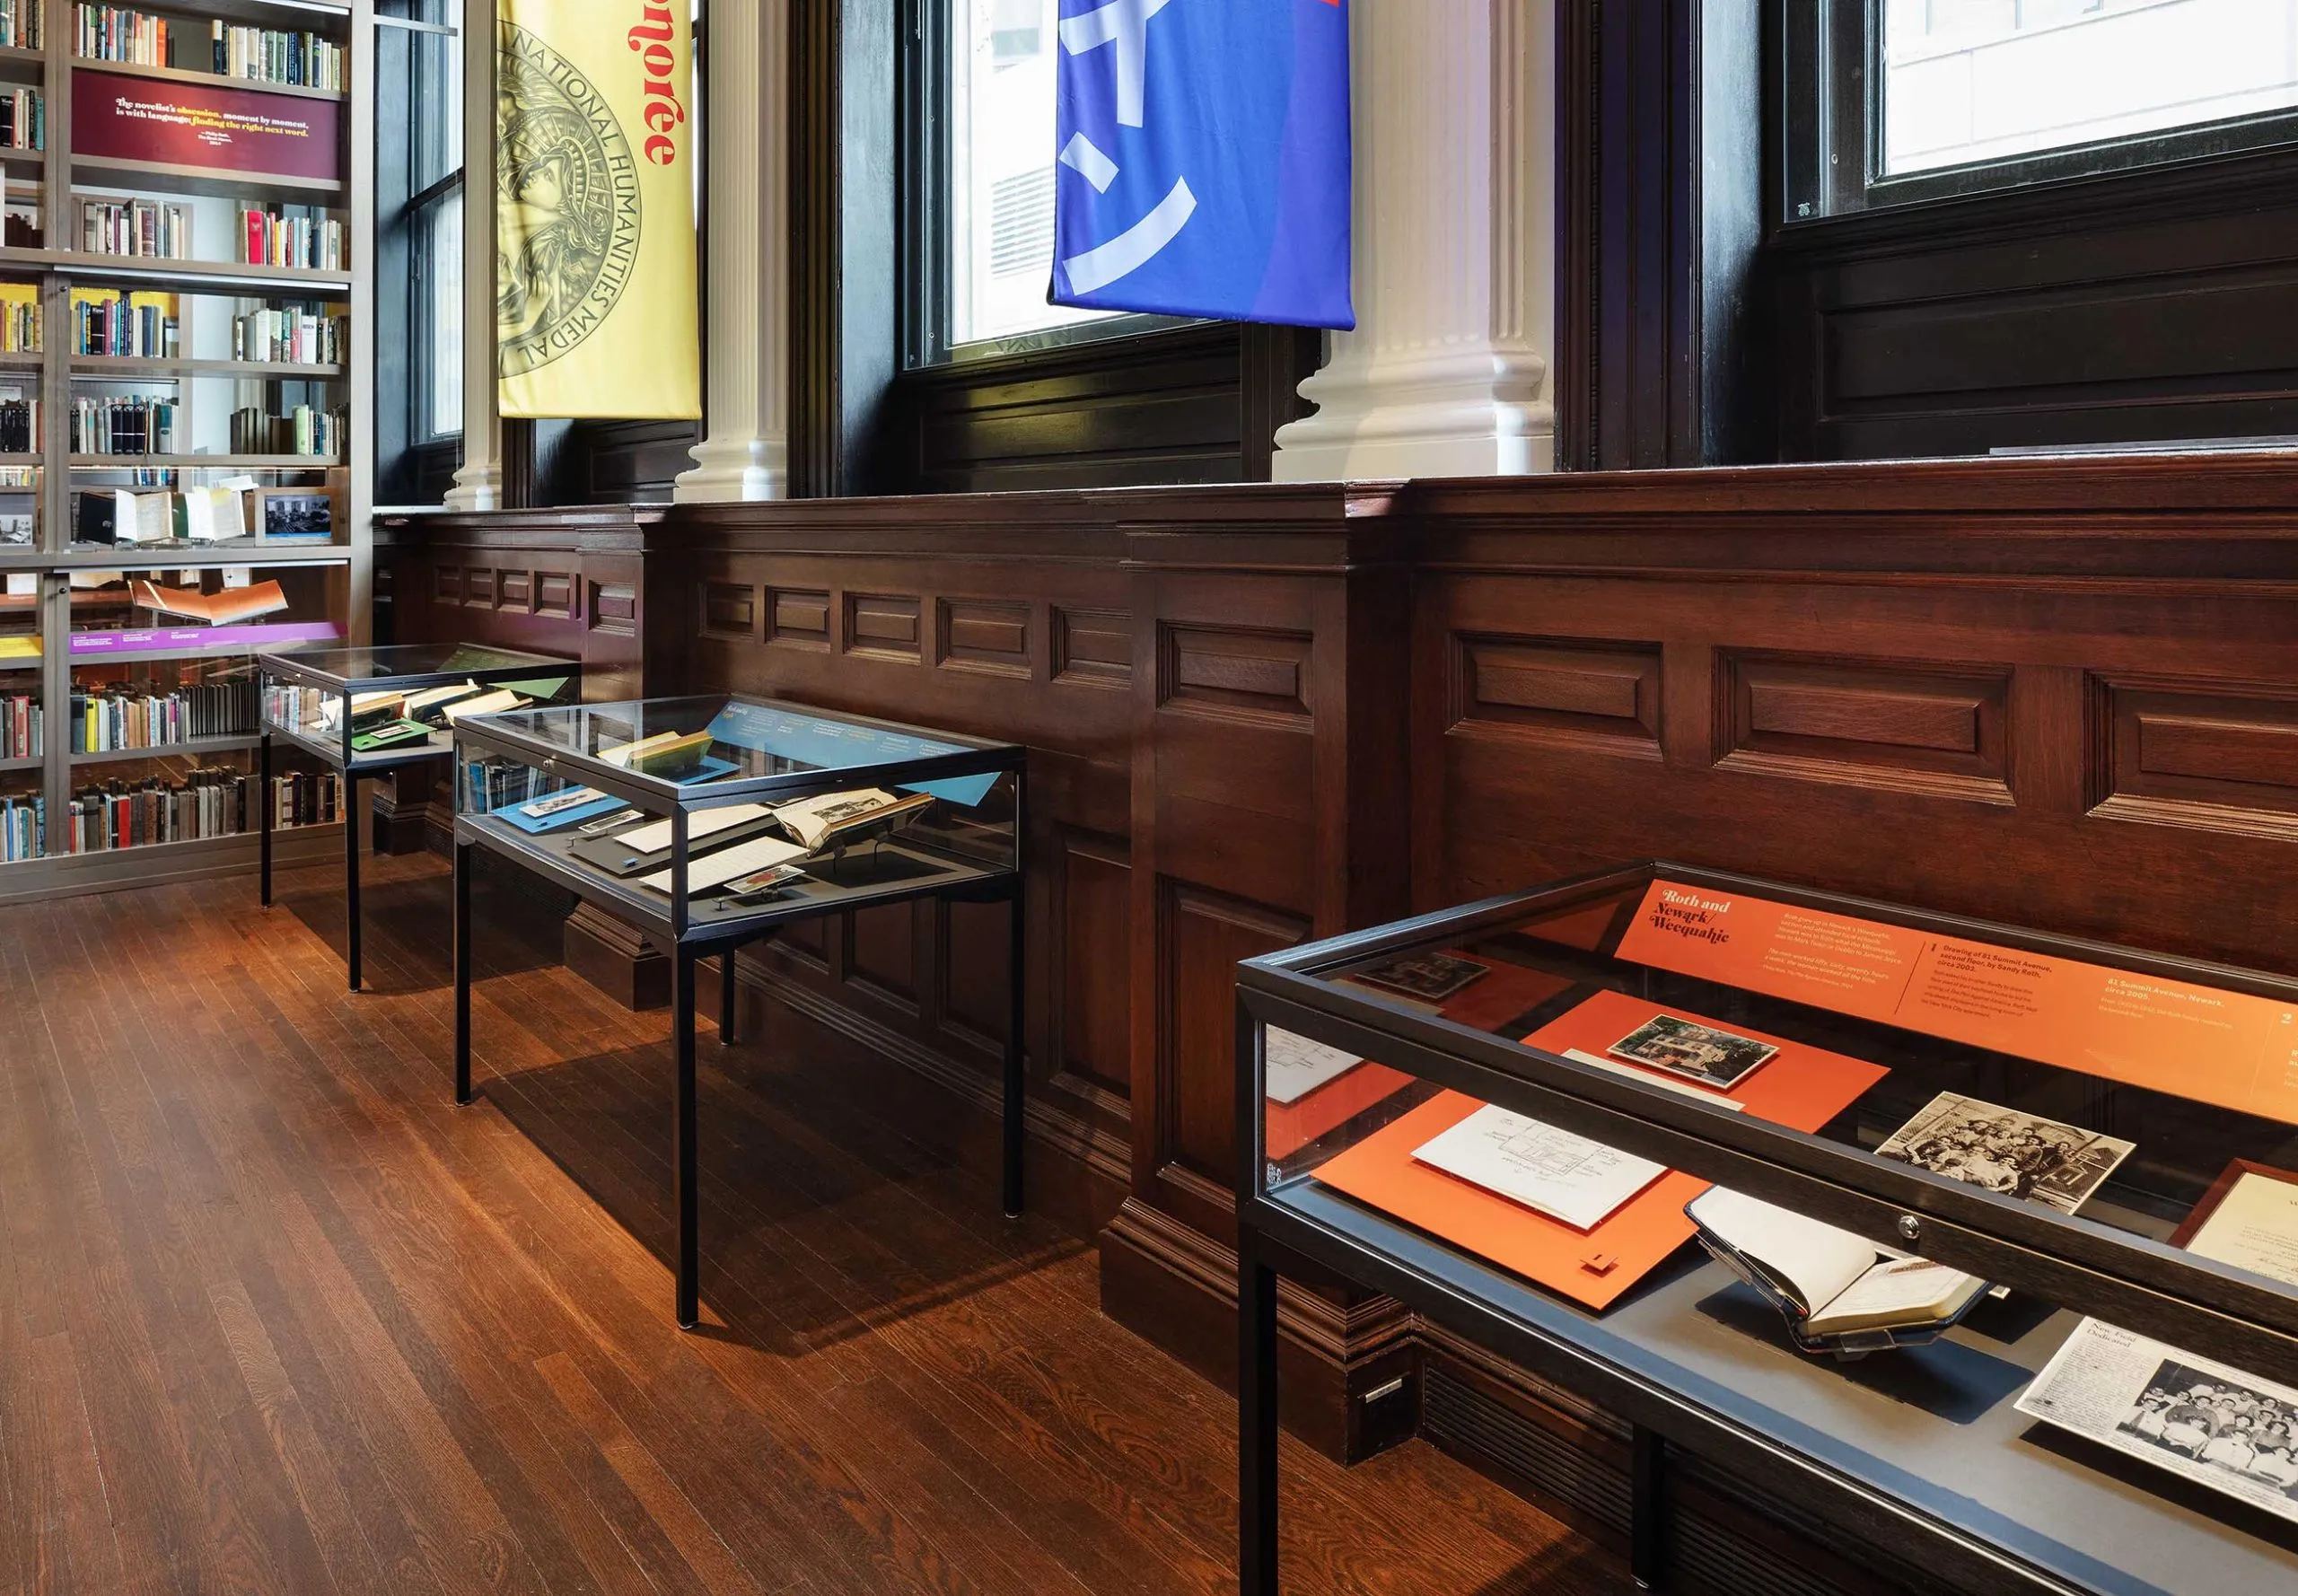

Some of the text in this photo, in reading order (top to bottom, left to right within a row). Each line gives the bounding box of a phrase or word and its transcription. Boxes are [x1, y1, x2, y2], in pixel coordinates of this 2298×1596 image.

[115, 97, 133, 109] The
[135, 102, 176, 112] novelist's
[223, 113, 259, 123] moment
[260, 116, 270, 125] by
[126, 110, 146, 118] with
[190, 116, 224, 128] finding
[226, 121, 241, 129] the
[242, 123, 263, 132] right
[285, 129, 309, 137] word.
[512, 30, 637, 364] NATIONAL HUMANITIES MEDAL
[1653, 901, 1716, 925] Newark/
[1662, 889, 1731, 913] Roth and
[1648, 916, 1729, 944] Weequahic
[1941, 953, 1965, 962] second
[1997, 963, 2020, 974] Sandy
[1943, 945, 1972, 956] Drawing
[1993, 955, 2022, 965] Summit
[2105, 987, 2125, 995] circa
[2120, 980, 2151, 992] Summit
